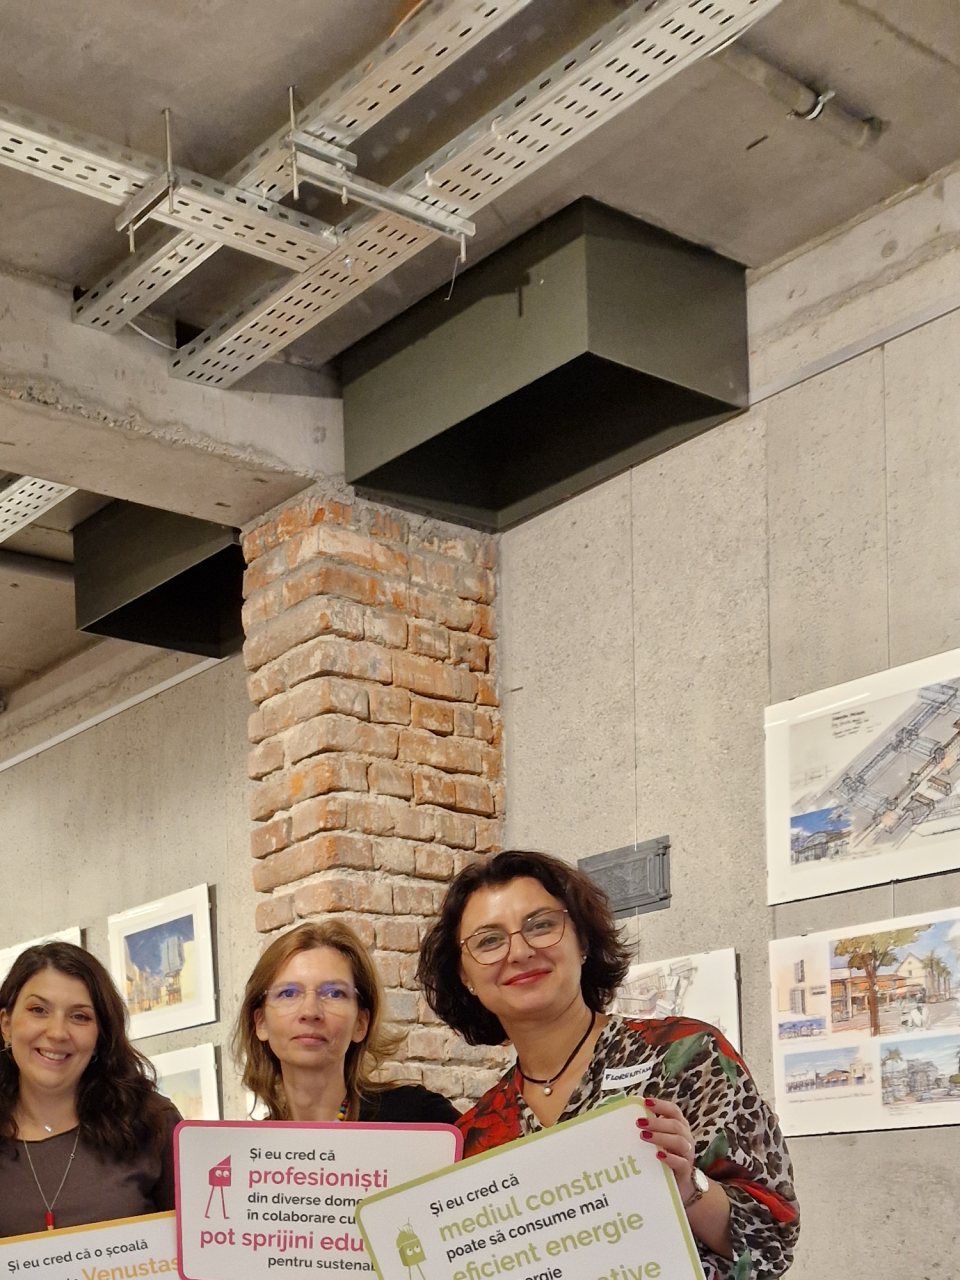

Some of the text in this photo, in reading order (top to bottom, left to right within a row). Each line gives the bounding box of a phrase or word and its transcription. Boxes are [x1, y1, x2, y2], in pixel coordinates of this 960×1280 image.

[249, 1147, 336, 1162] Și eu cred că
[249, 1166, 388, 1192] profesioniști
[247, 1192, 268, 1204] din
[271, 1192, 322, 1206] diverse
[429, 1173, 520, 1218] Și eu cred că
[439, 1155, 641, 1242] mediul construit
[246, 1208, 356, 1225] în colaborare cu
[446, 1193, 609, 1263] poate să consume mai
[200, 1228, 364, 1253] pot sprijini edu
[546, 1213, 643, 1256] energie
[7, 1239, 149, 1274] Și eu cred că o școală
[268, 1256, 313, 1269] pentru
